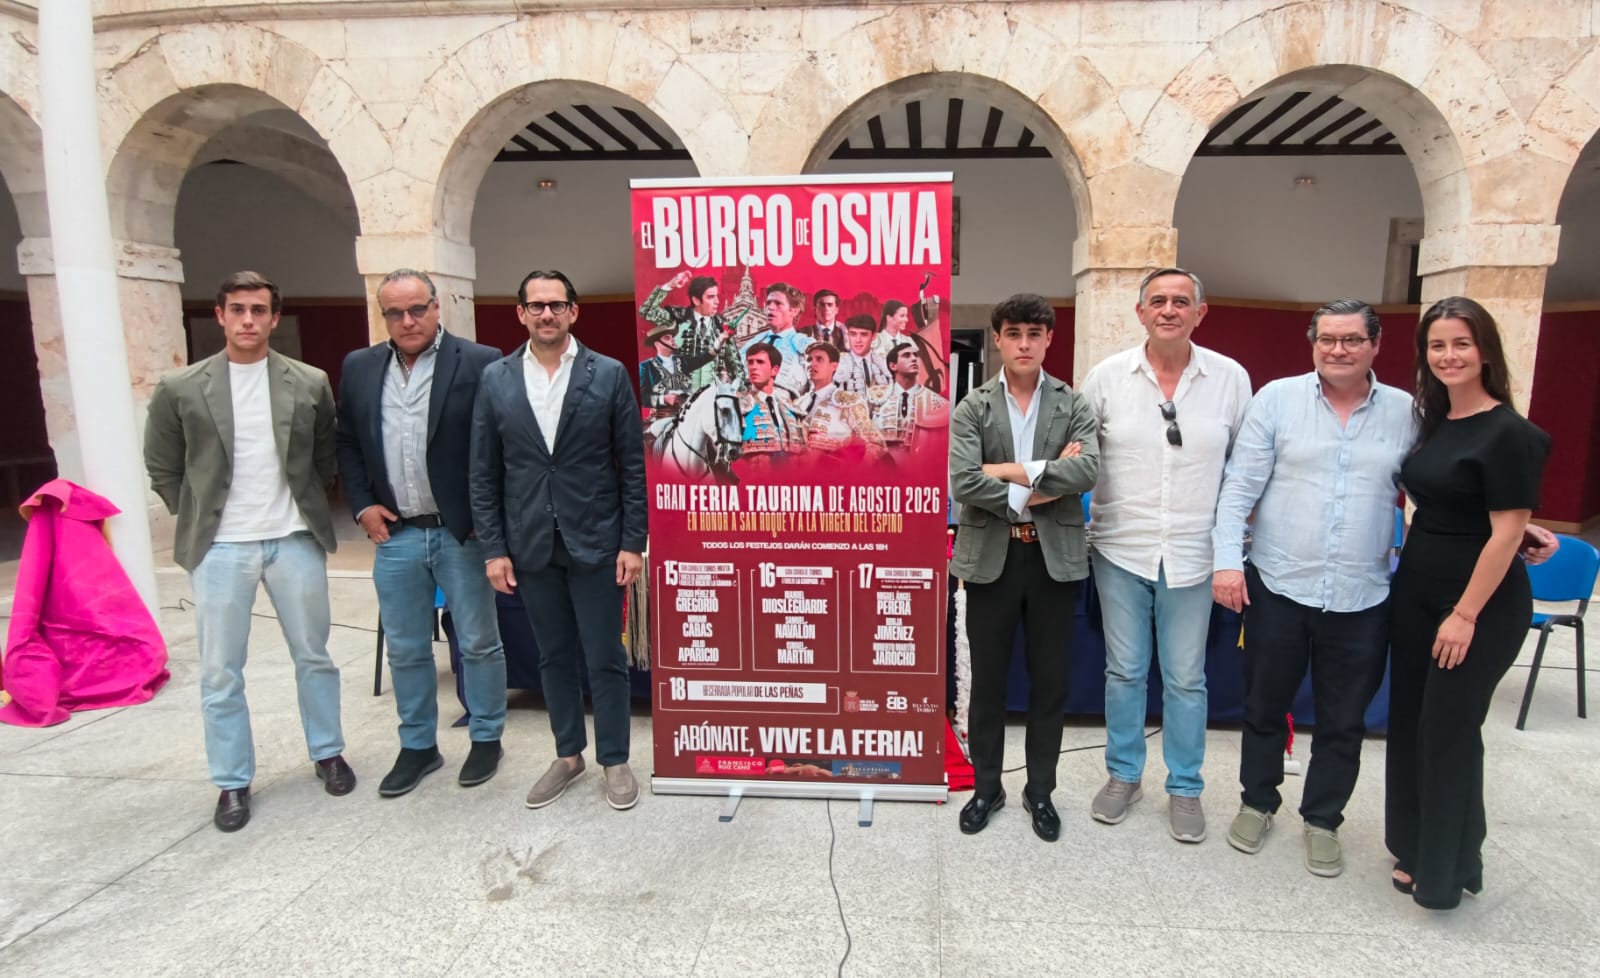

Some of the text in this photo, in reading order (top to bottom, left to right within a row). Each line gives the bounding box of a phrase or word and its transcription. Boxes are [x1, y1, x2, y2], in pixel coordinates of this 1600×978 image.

[641, 191, 941, 269] EL BURGO DE OSMA
[656, 484, 940, 514] GRAN FERIA TAURINA DE AGOSTO 2026
[688, 512, 903, 538] EN HONOR A SAN ROQUE Y A LA VIRGEN DEL ESPINO
[702, 541, 728, 549] TODOS
[746, 542, 783, 550] FESTEJOS
[784, 541, 810, 550] DARÁN
[859, 543, 874, 551] LAS
[664, 560, 679, 586] 15
[758, 562, 775, 588] 16
[858, 563, 874, 589] 17
[676, 597, 719, 612] GREGORIO
[762, 598, 828, 614] DIOSLEGUARDE
[876, 600, 911, 615] PERERA
[775, 621, 816, 639] NAVALÓN
[678, 647, 719, 662] APARICIO
[777, 647, 814, 664] MARTÍN
[873, 650, 915, 666] JAROCHO
[669, 677, 686, 700] 18
[703, 685, 804, 699] BECERRADA POPULAR DE LAS PEÑAS
[674, 721, 923, 757] ¡ABÓNATE, VIVE LA FERIA!
